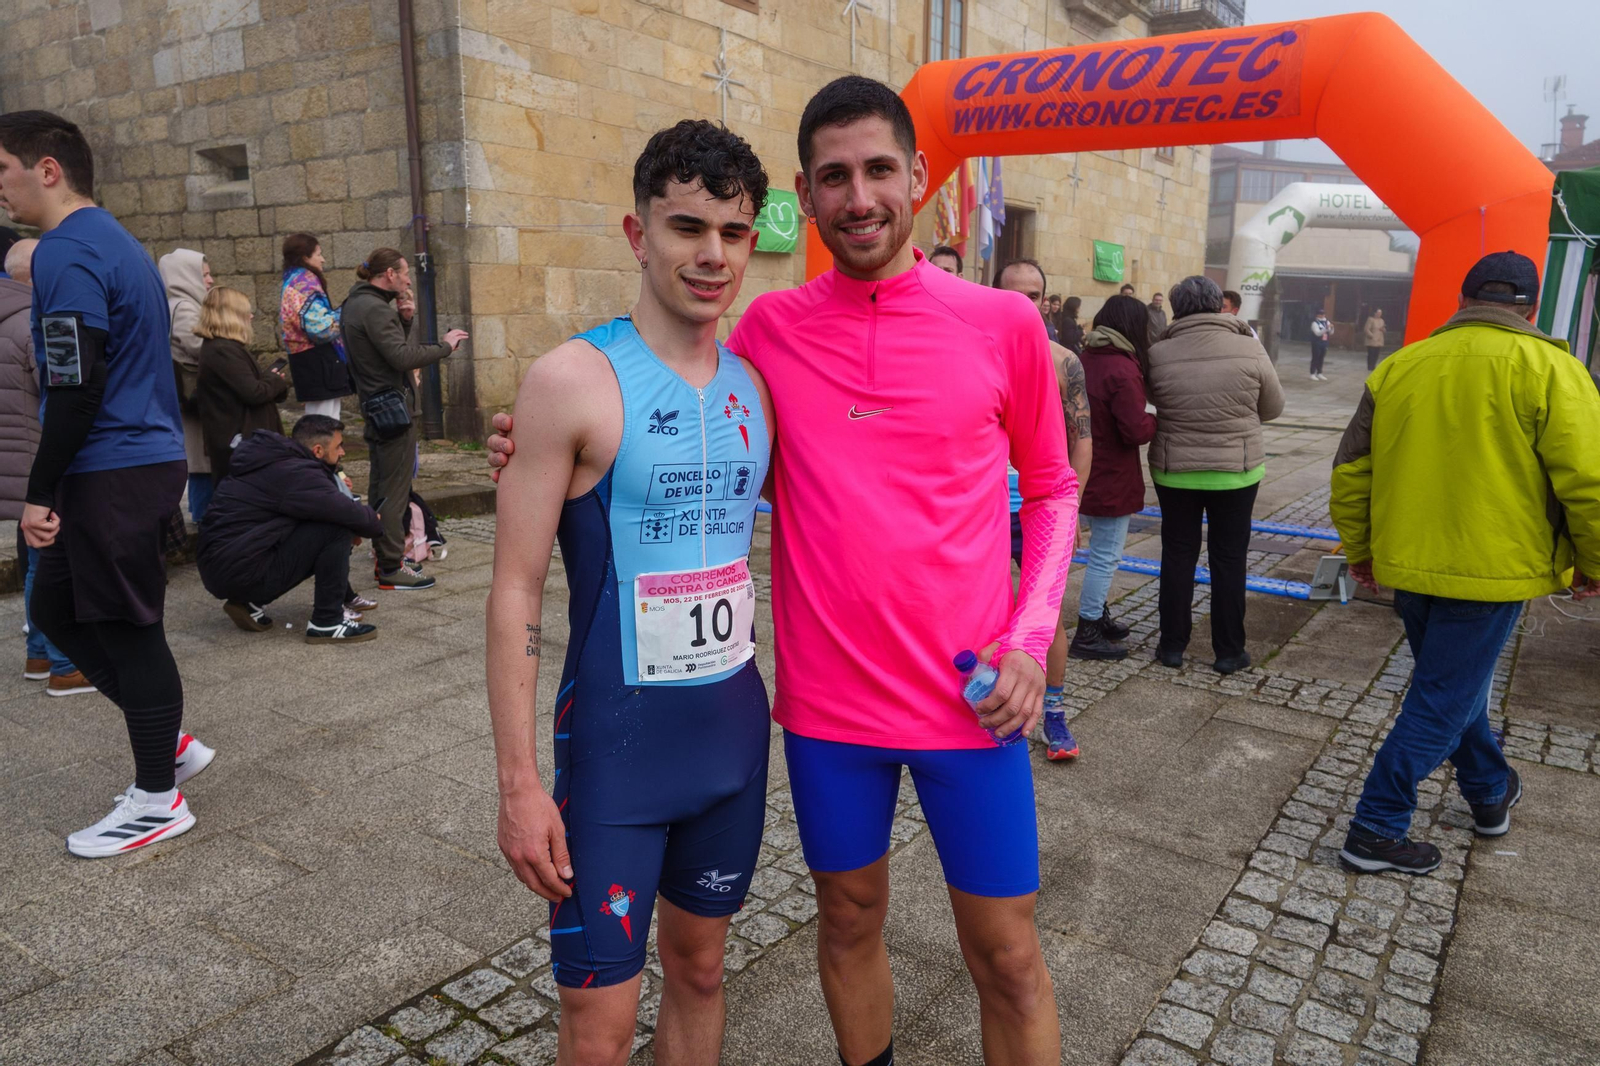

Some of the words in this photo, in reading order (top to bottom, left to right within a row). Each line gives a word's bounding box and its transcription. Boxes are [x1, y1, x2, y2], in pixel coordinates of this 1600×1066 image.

[953, 30, 1298, 100] CRONOTEC
[953, 89, 1283, 134] WWW.CRONOTEC.ES
[1319, 193, 1372, 209] HOTEL
[1316, 211, 1402, 222] www.hotelrectoral.c
[647, 424, 679, 436] ZICO
[659, 469, 721, 484] CONCELLO
[664, 487, 682, 498] DE
[684, 483, 713, 496] VIGO
[680, 508, 727, 521] XUNTA
[678, 523, 698, 536] DE
[704, 521, 745, 535] GALICIA
[671, 565, 736, 584] CORREMOS
[648, 584, 703, 595] CONTRA
[716, 571, 747, 587] CANCRO
[704, 588, 729, 599] FEBREIRO
[689, 598, 733, 647] 10
[695, 646, 727, 658] RODRÍGUEZ
[696, 877, 732, 893] ZICO
